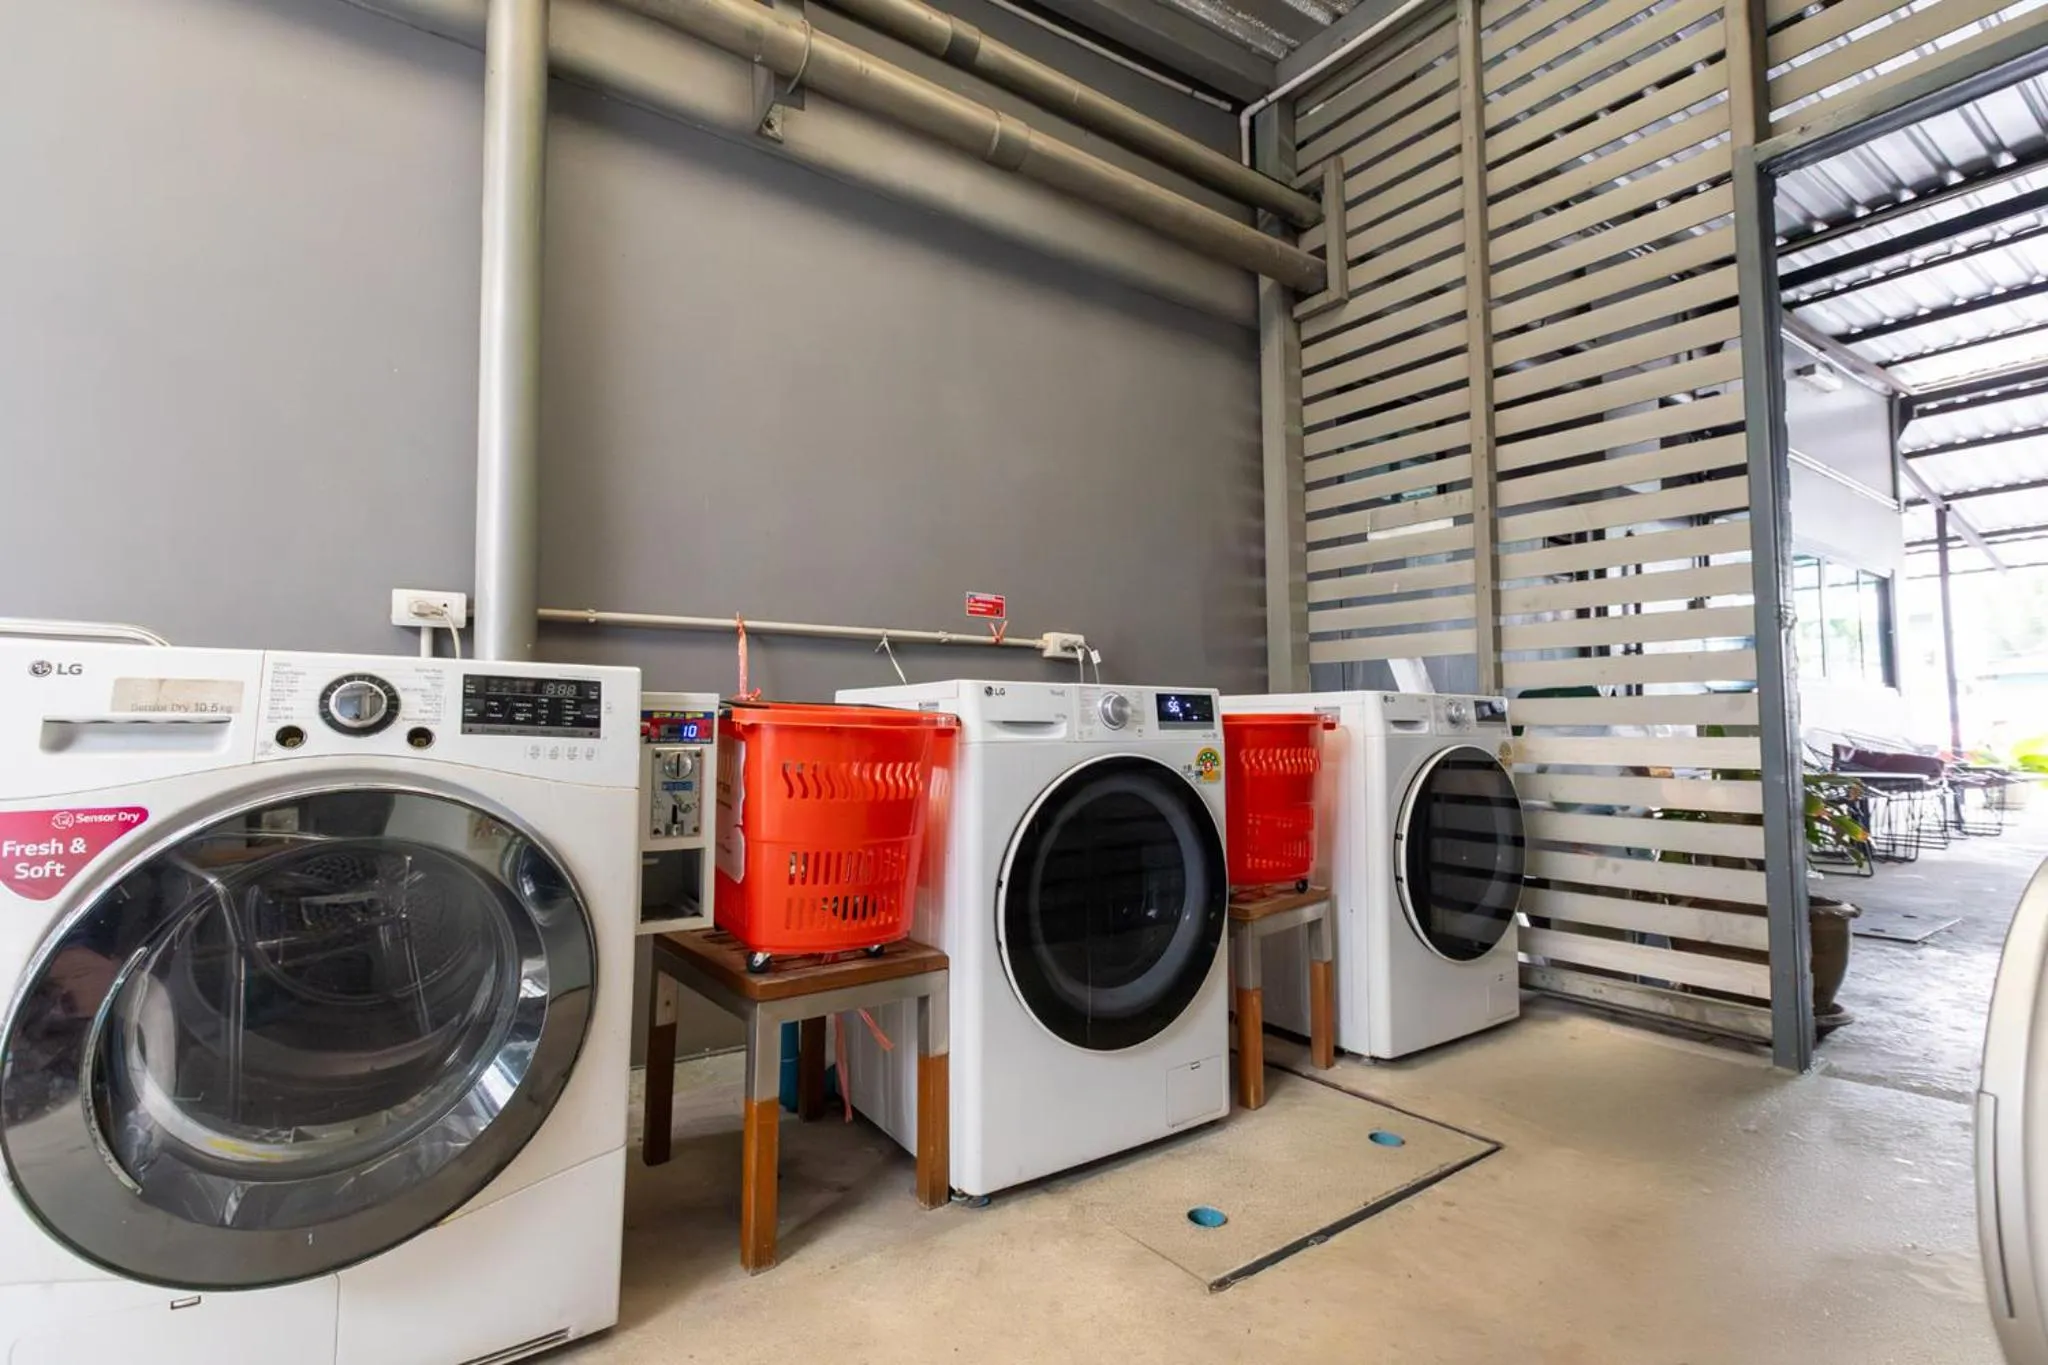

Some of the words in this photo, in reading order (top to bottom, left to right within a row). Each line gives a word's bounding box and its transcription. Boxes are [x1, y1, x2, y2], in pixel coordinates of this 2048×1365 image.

[56, 663, 83, 675] LG
[683, 725, 698, 738] 10
[75, 812, 116, 824] Sensor
[118, 811, 140, 824] Dry
[2, 838, 64, 858] Fresh
[69, 836, 87, 854] &
[14, 860, 66, 880] Soft
